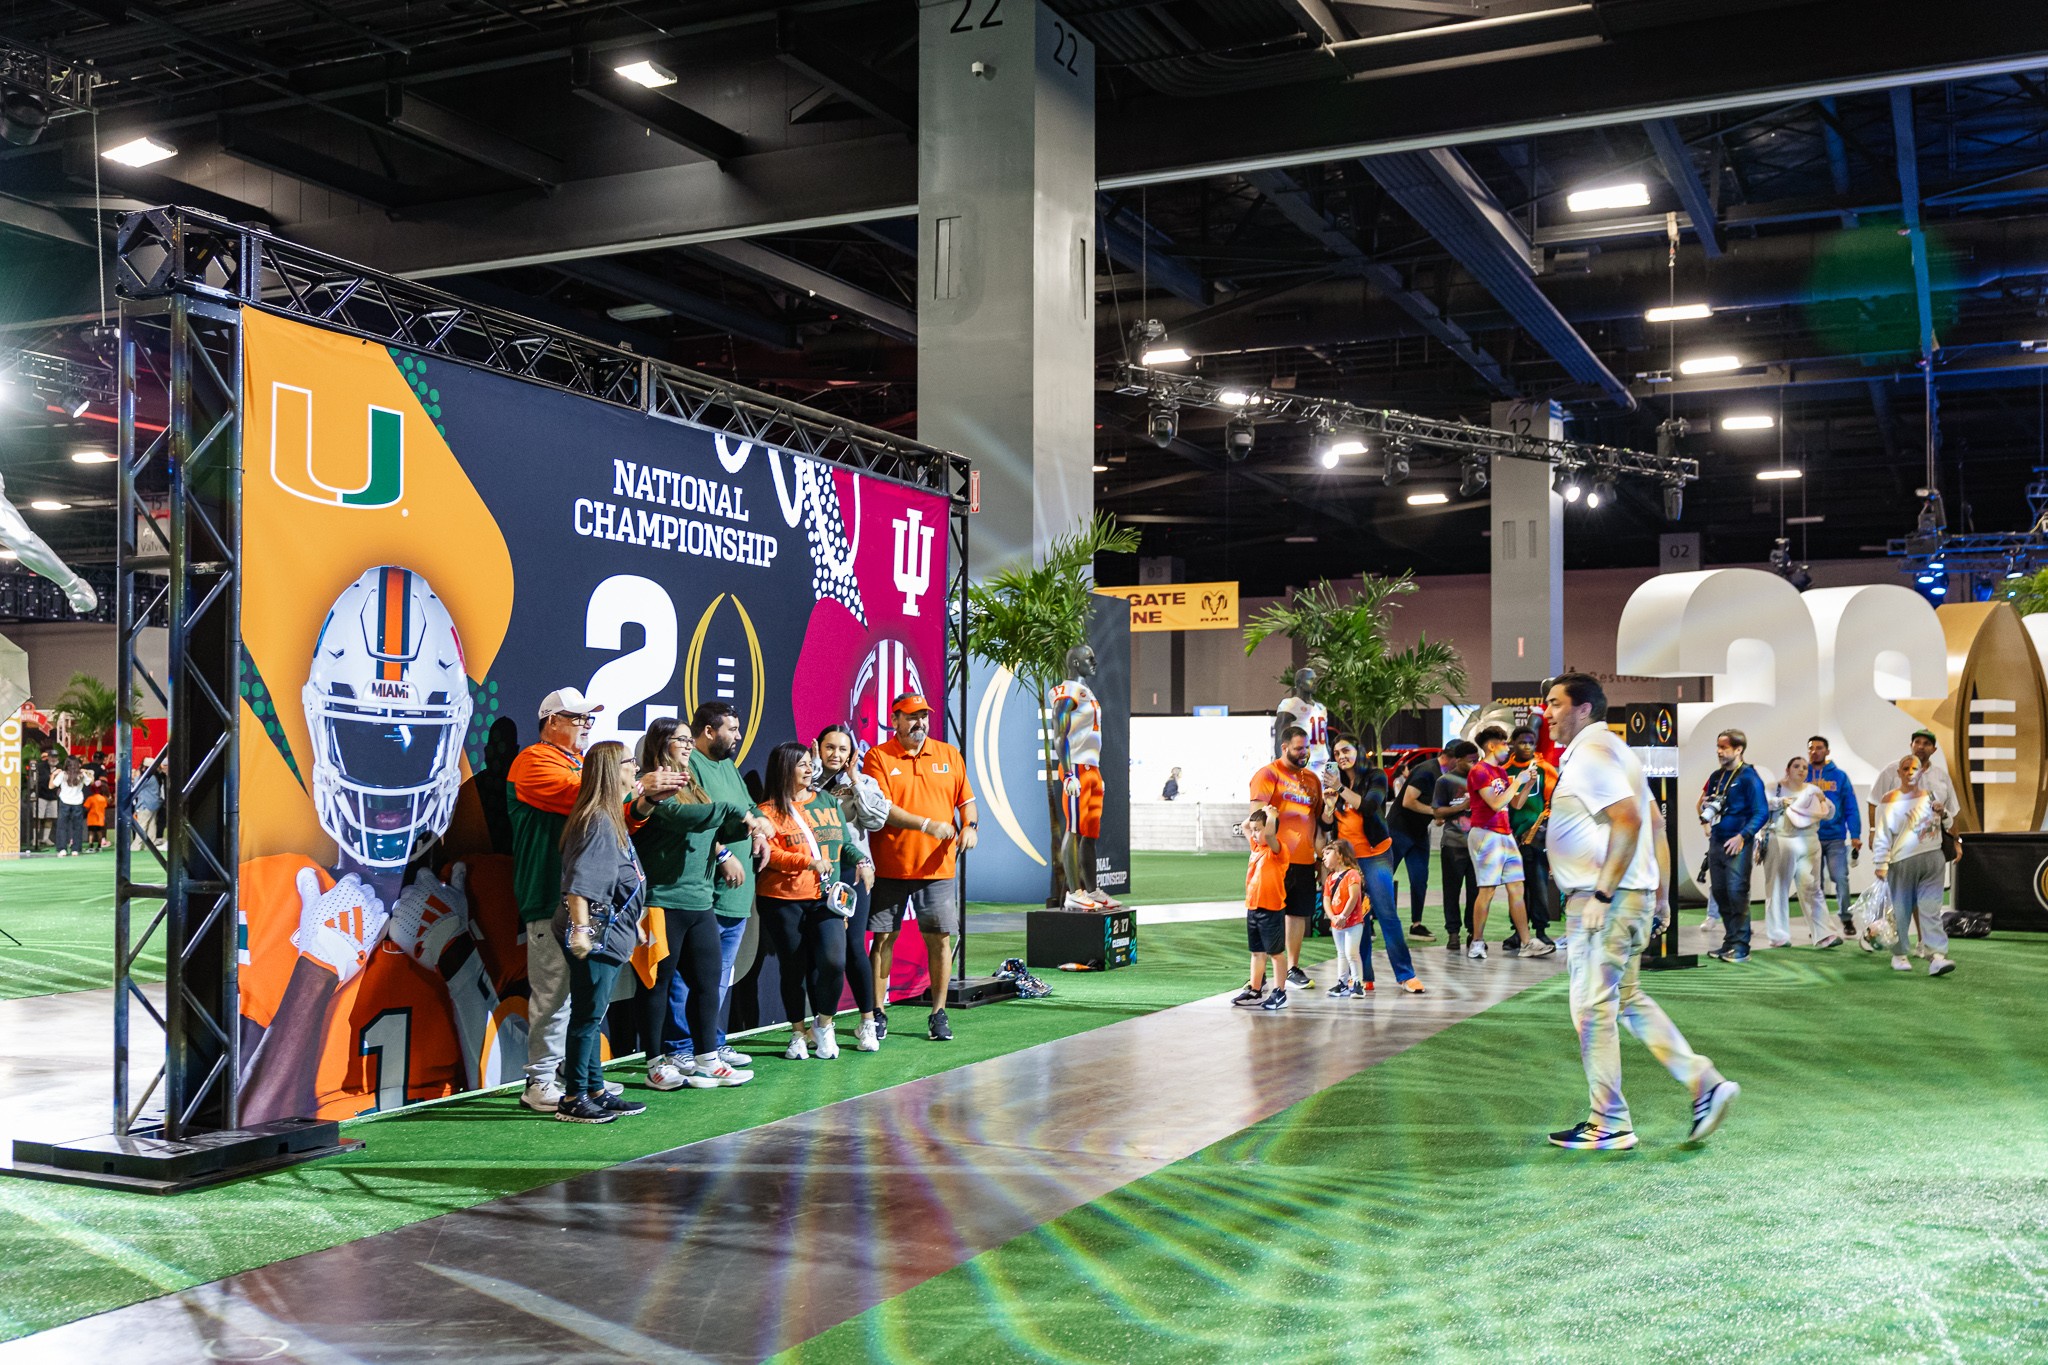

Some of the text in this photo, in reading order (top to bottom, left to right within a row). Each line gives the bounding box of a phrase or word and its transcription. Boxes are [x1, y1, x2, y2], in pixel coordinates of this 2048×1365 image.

[950, 0, 1003, 34] 22
[1054, 21, 1078, 77] 22
[270, 378, 404, 510] U
[613, 458, 749, 522] NATIONAL
[574, 497, 778, 568] CHAMPIONSHIP
[1669, 545, 1690, 558] 02
[1126, 592, 1186, 606] GATE
[1131, 611, 1162, 624] NE
[371, 682, 409, 699] MIAMI
[1053, 685, 1065, 696] 17
[1309, 716, 1326, 745] 16
[932, 763, 949, 774] U
[1096, 858, 1112, 871] NAL
[1096, 871, 1128, 887] PIONSHIP
